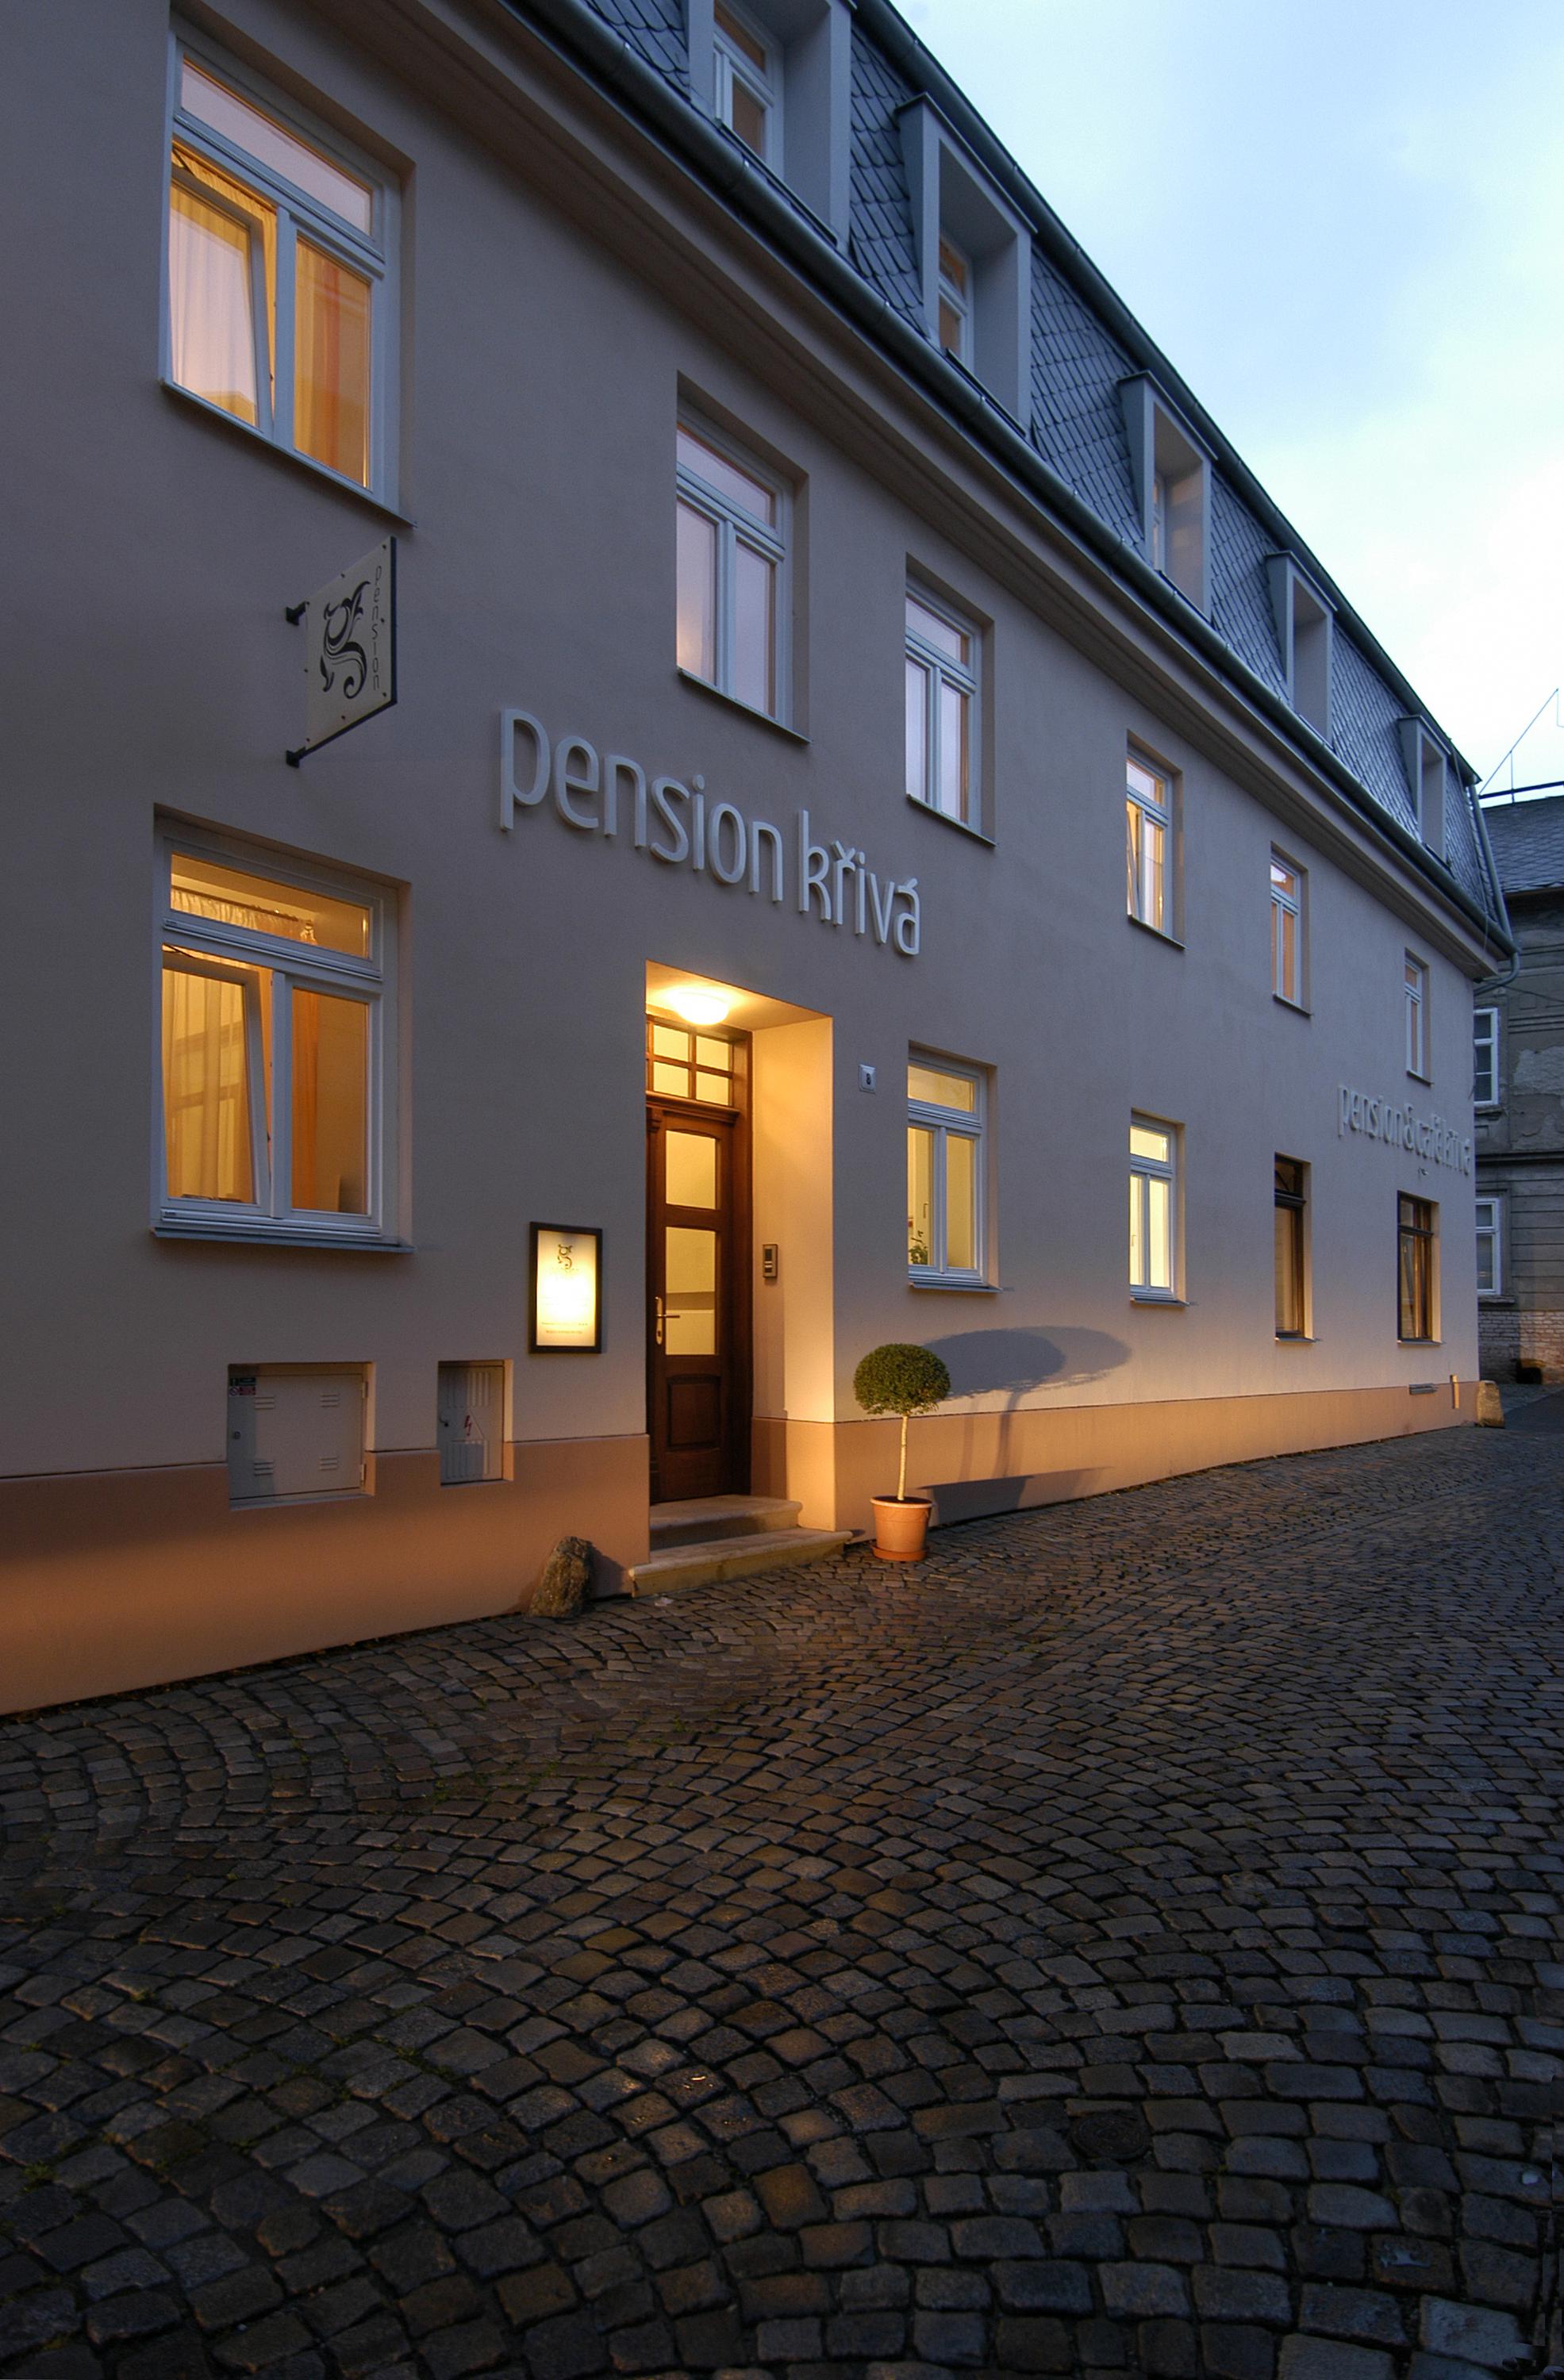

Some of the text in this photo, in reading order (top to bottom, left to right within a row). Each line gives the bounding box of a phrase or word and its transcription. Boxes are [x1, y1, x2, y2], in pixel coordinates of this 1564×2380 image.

[371, 565, 382, 691] pension
[500, 708, 920, 956] pension křivá
